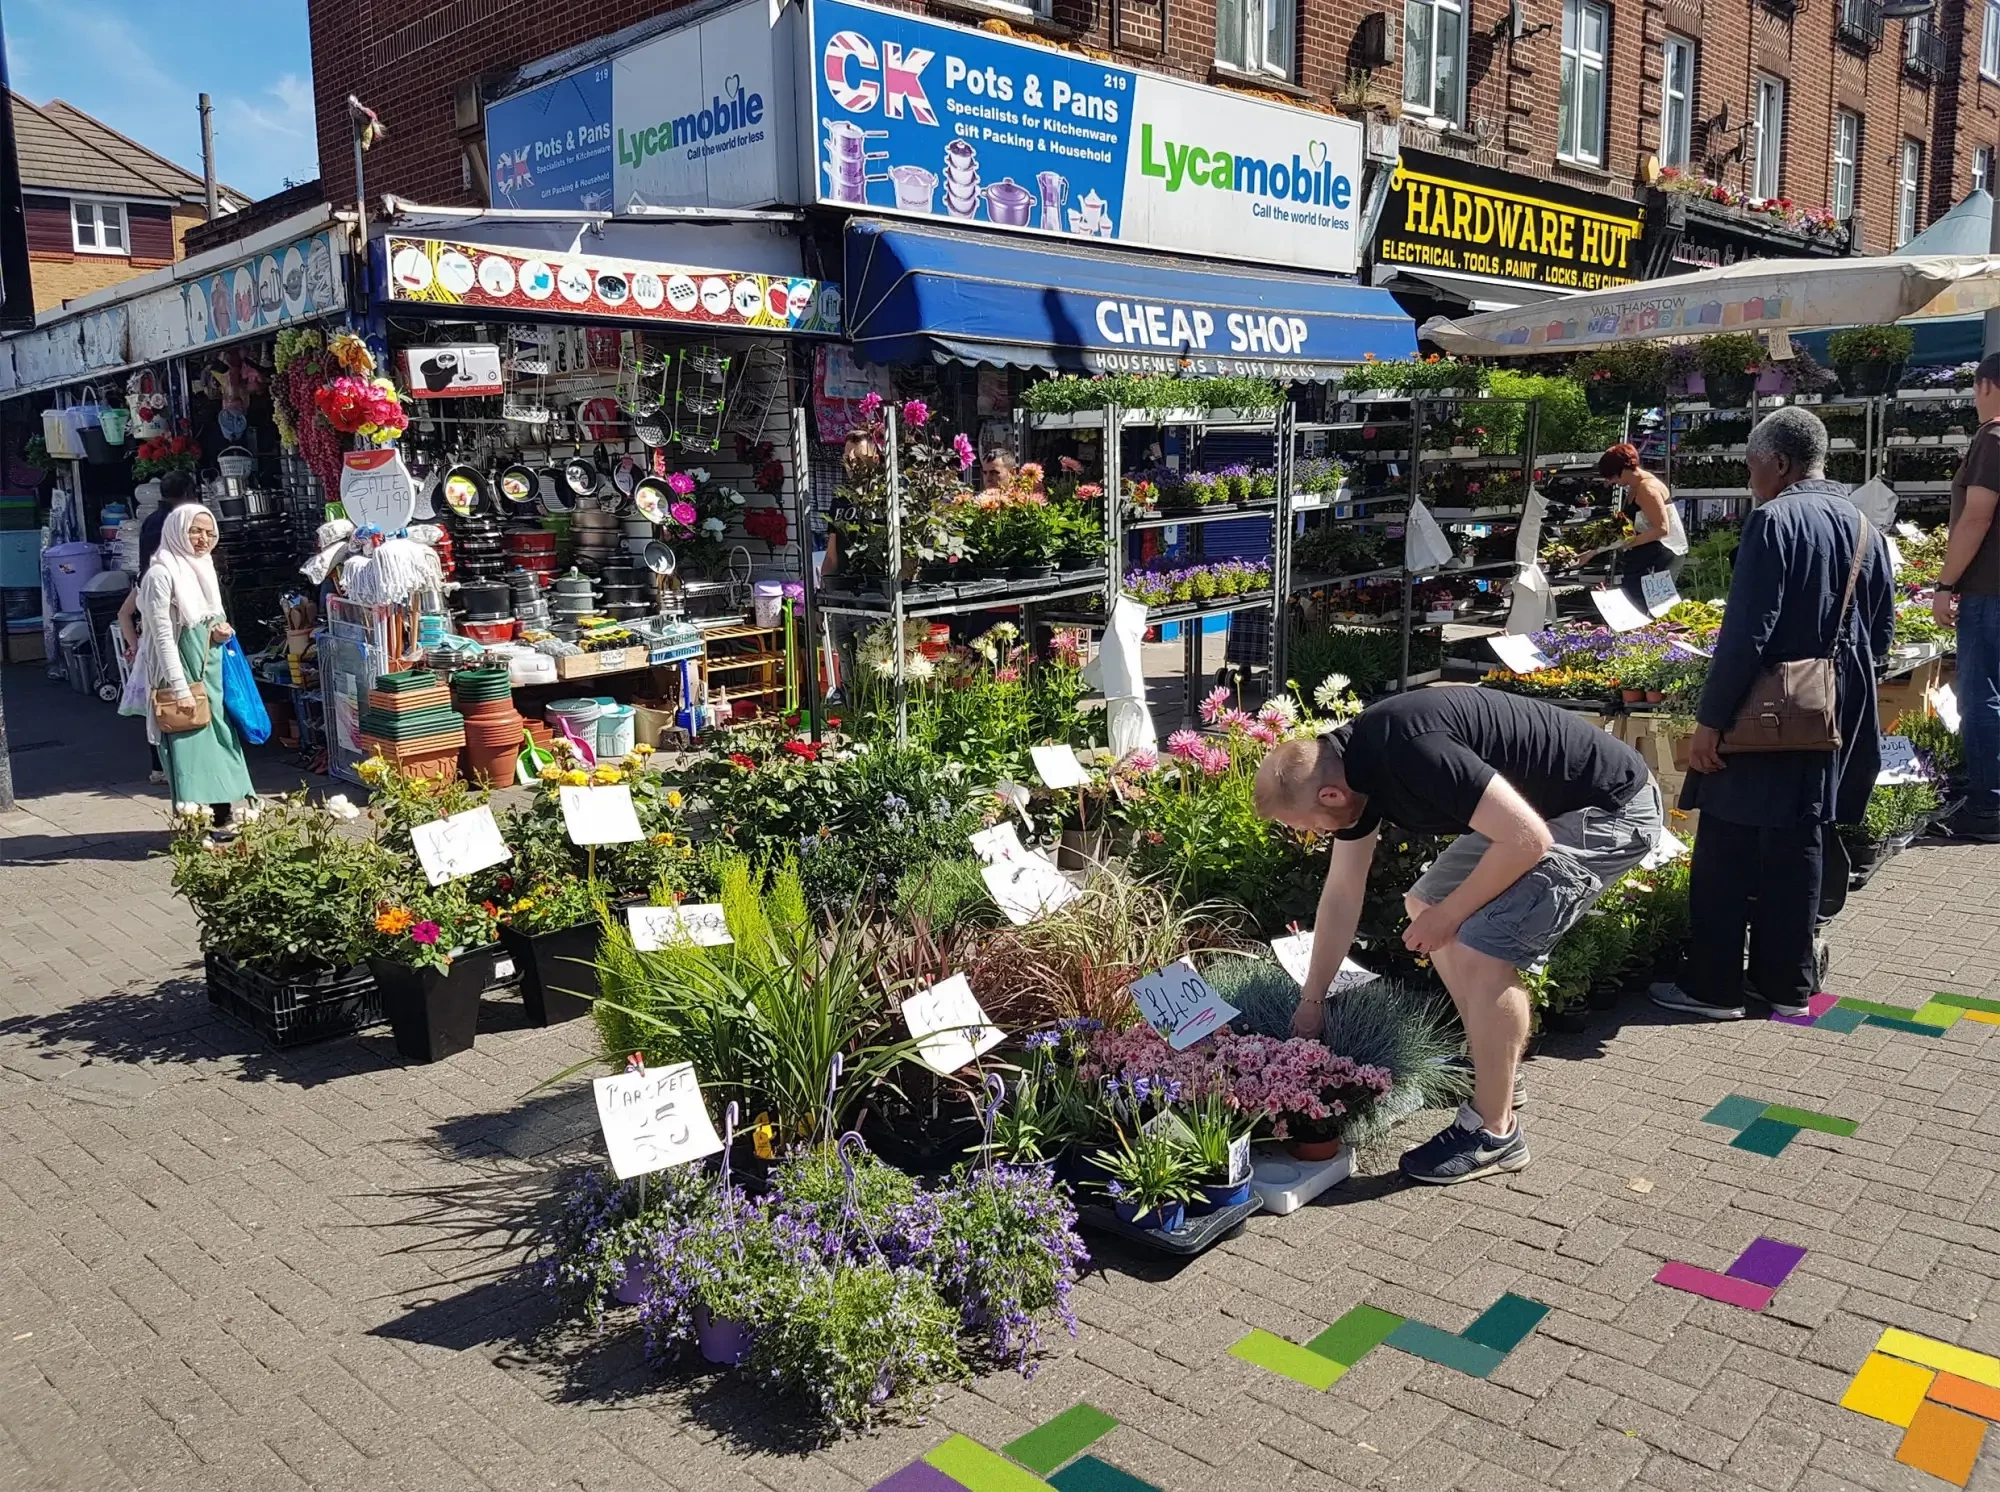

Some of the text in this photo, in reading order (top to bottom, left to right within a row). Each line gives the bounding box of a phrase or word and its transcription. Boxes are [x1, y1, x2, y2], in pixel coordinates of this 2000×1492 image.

[595, 67, 609, 83] 219
[823, 30, 940, 128] CK
[944, 55, 1120, 124] Pots & Pans
[1104, 73, 1127, 91] 219
[617, 82, 765, 169] Lycamobile
[946, 97, 1119, 145] Specialists for Kitchenware
[534, 122, 611, 162] Pots & Pans
[536, 144, 611, 175] Specialists for Kitchenware
[687, 131, 765, 161] Call the world for less
[954, 121, 1112, 164] Gift Packing & Household
[496, 142, 536, 195] CK
[552, 183, 574, 196] Packing
[580, 171, 610, 188] Household
[1141, 123, 1351, 210] Lycamobile
[1252, 202, 1350, 231] Call the world for less
[1404, 180, 1632, 269] HARDWARE HUT
[1582, 271, 1601, 290] KEY
[1602, 274, 1640, 289] CUTT
[1591, 296, 1687, 318] WALTHAMSTOW
[1095, 299, 1308, 355] CHEAP SHOP
[1234, 361, 1266, 376] GIFT
[1273, 363, 1317, 377] PACKS
[347, 473, 405, 498] SALE
